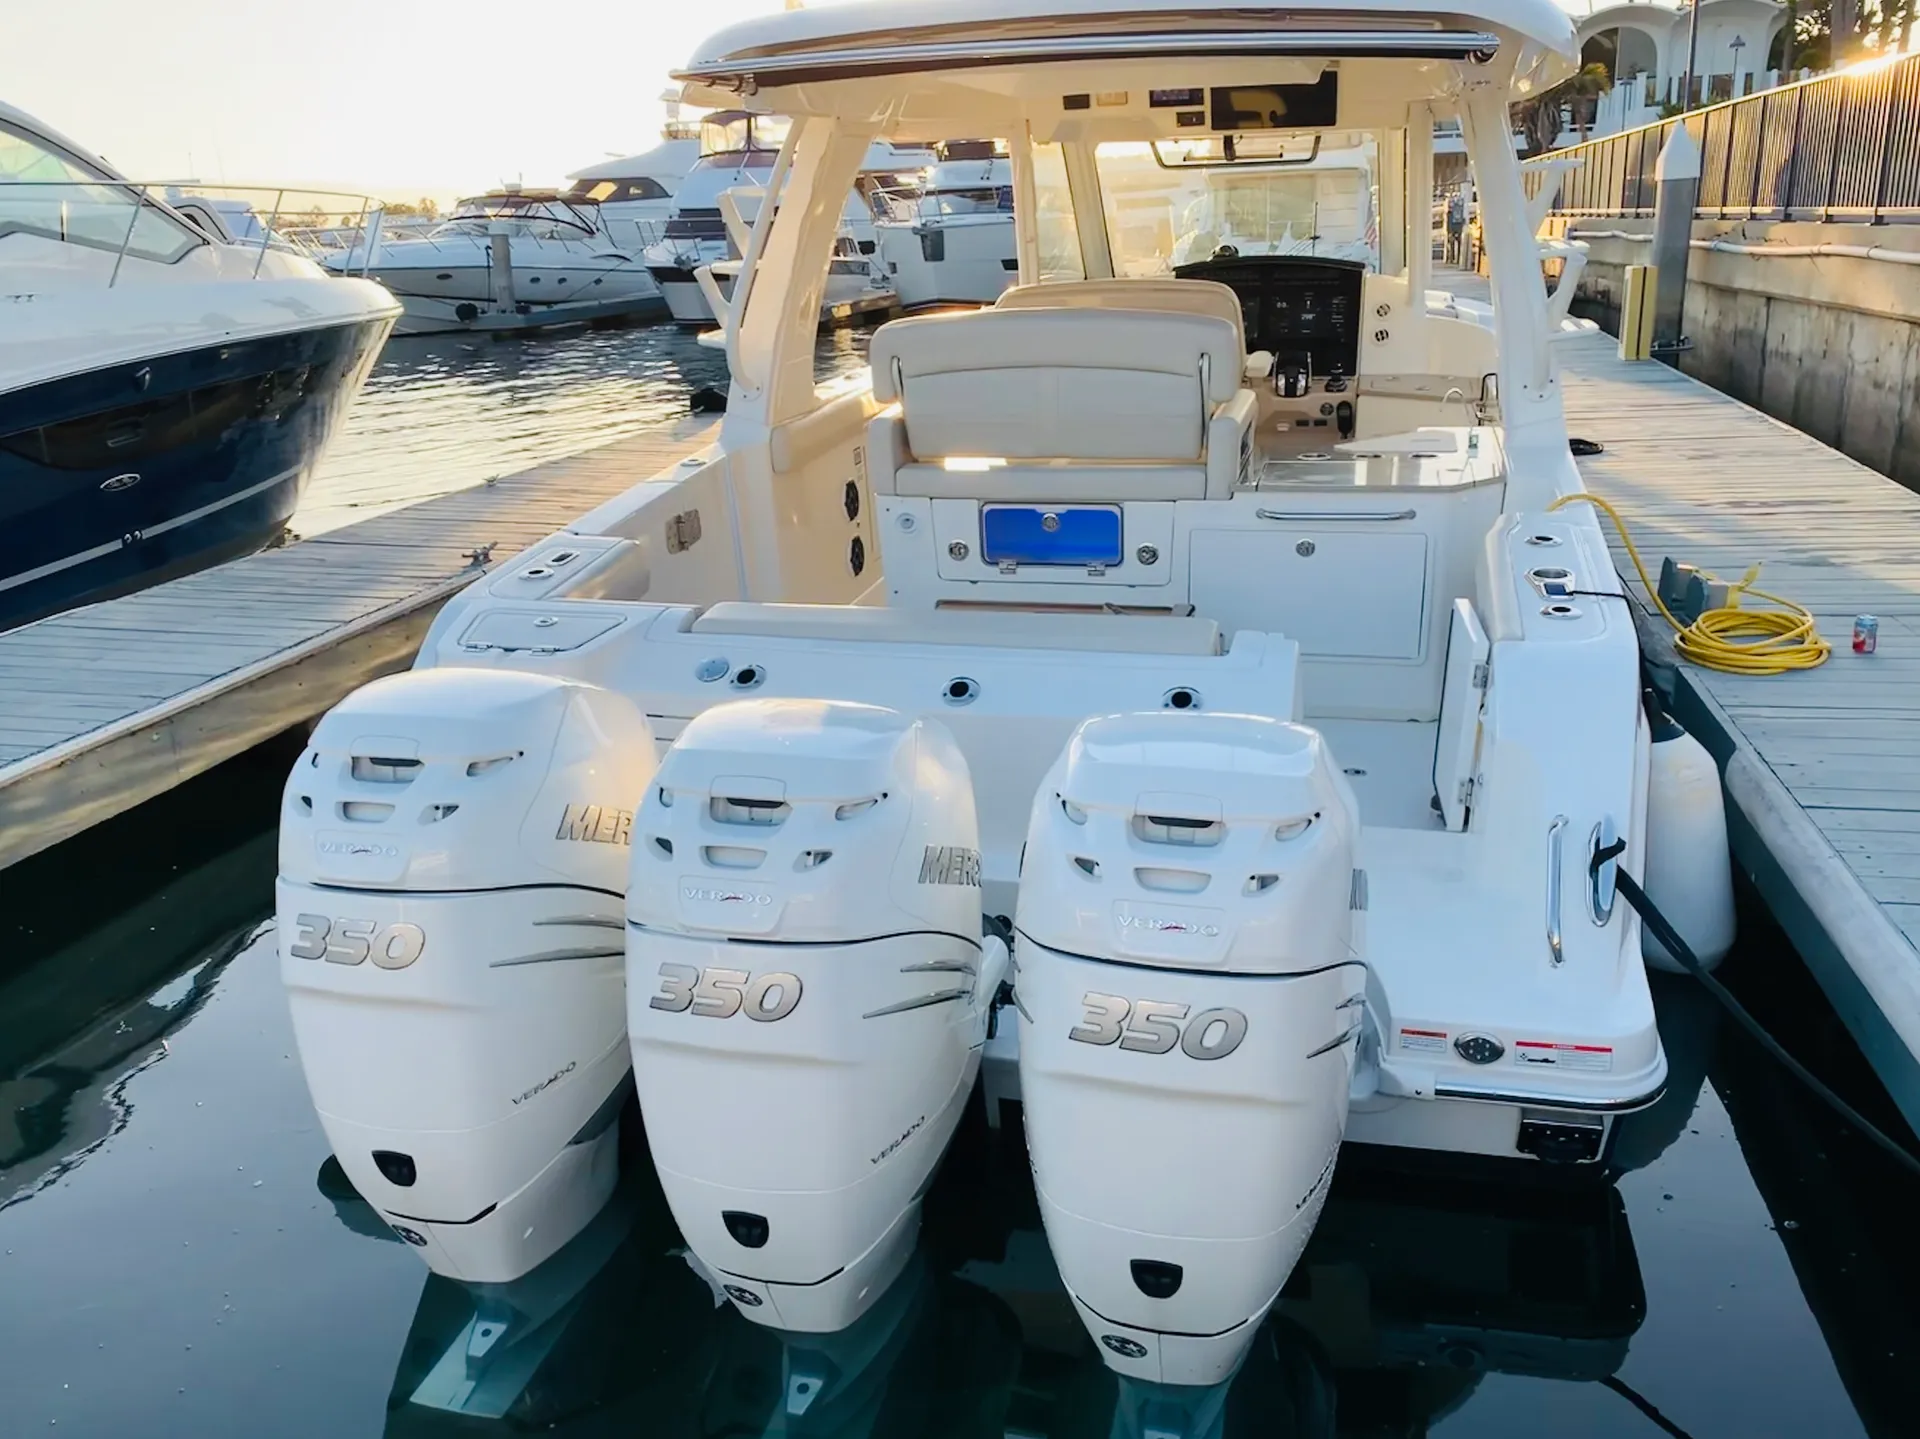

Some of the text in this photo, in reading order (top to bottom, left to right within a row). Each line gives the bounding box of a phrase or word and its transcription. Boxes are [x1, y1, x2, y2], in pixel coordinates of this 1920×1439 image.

[683, 886, 773, 907] VERADO
[290, 913, 426, 970] 350
[1117, 915, 1219, 938] VERADO
[649, 962, 803, 1022] 350
[1068, 991, 1248, 1060] 350
[511, 1061, 577, 1105] VERADO
[870, 1115, 926, 1165] VERADO
